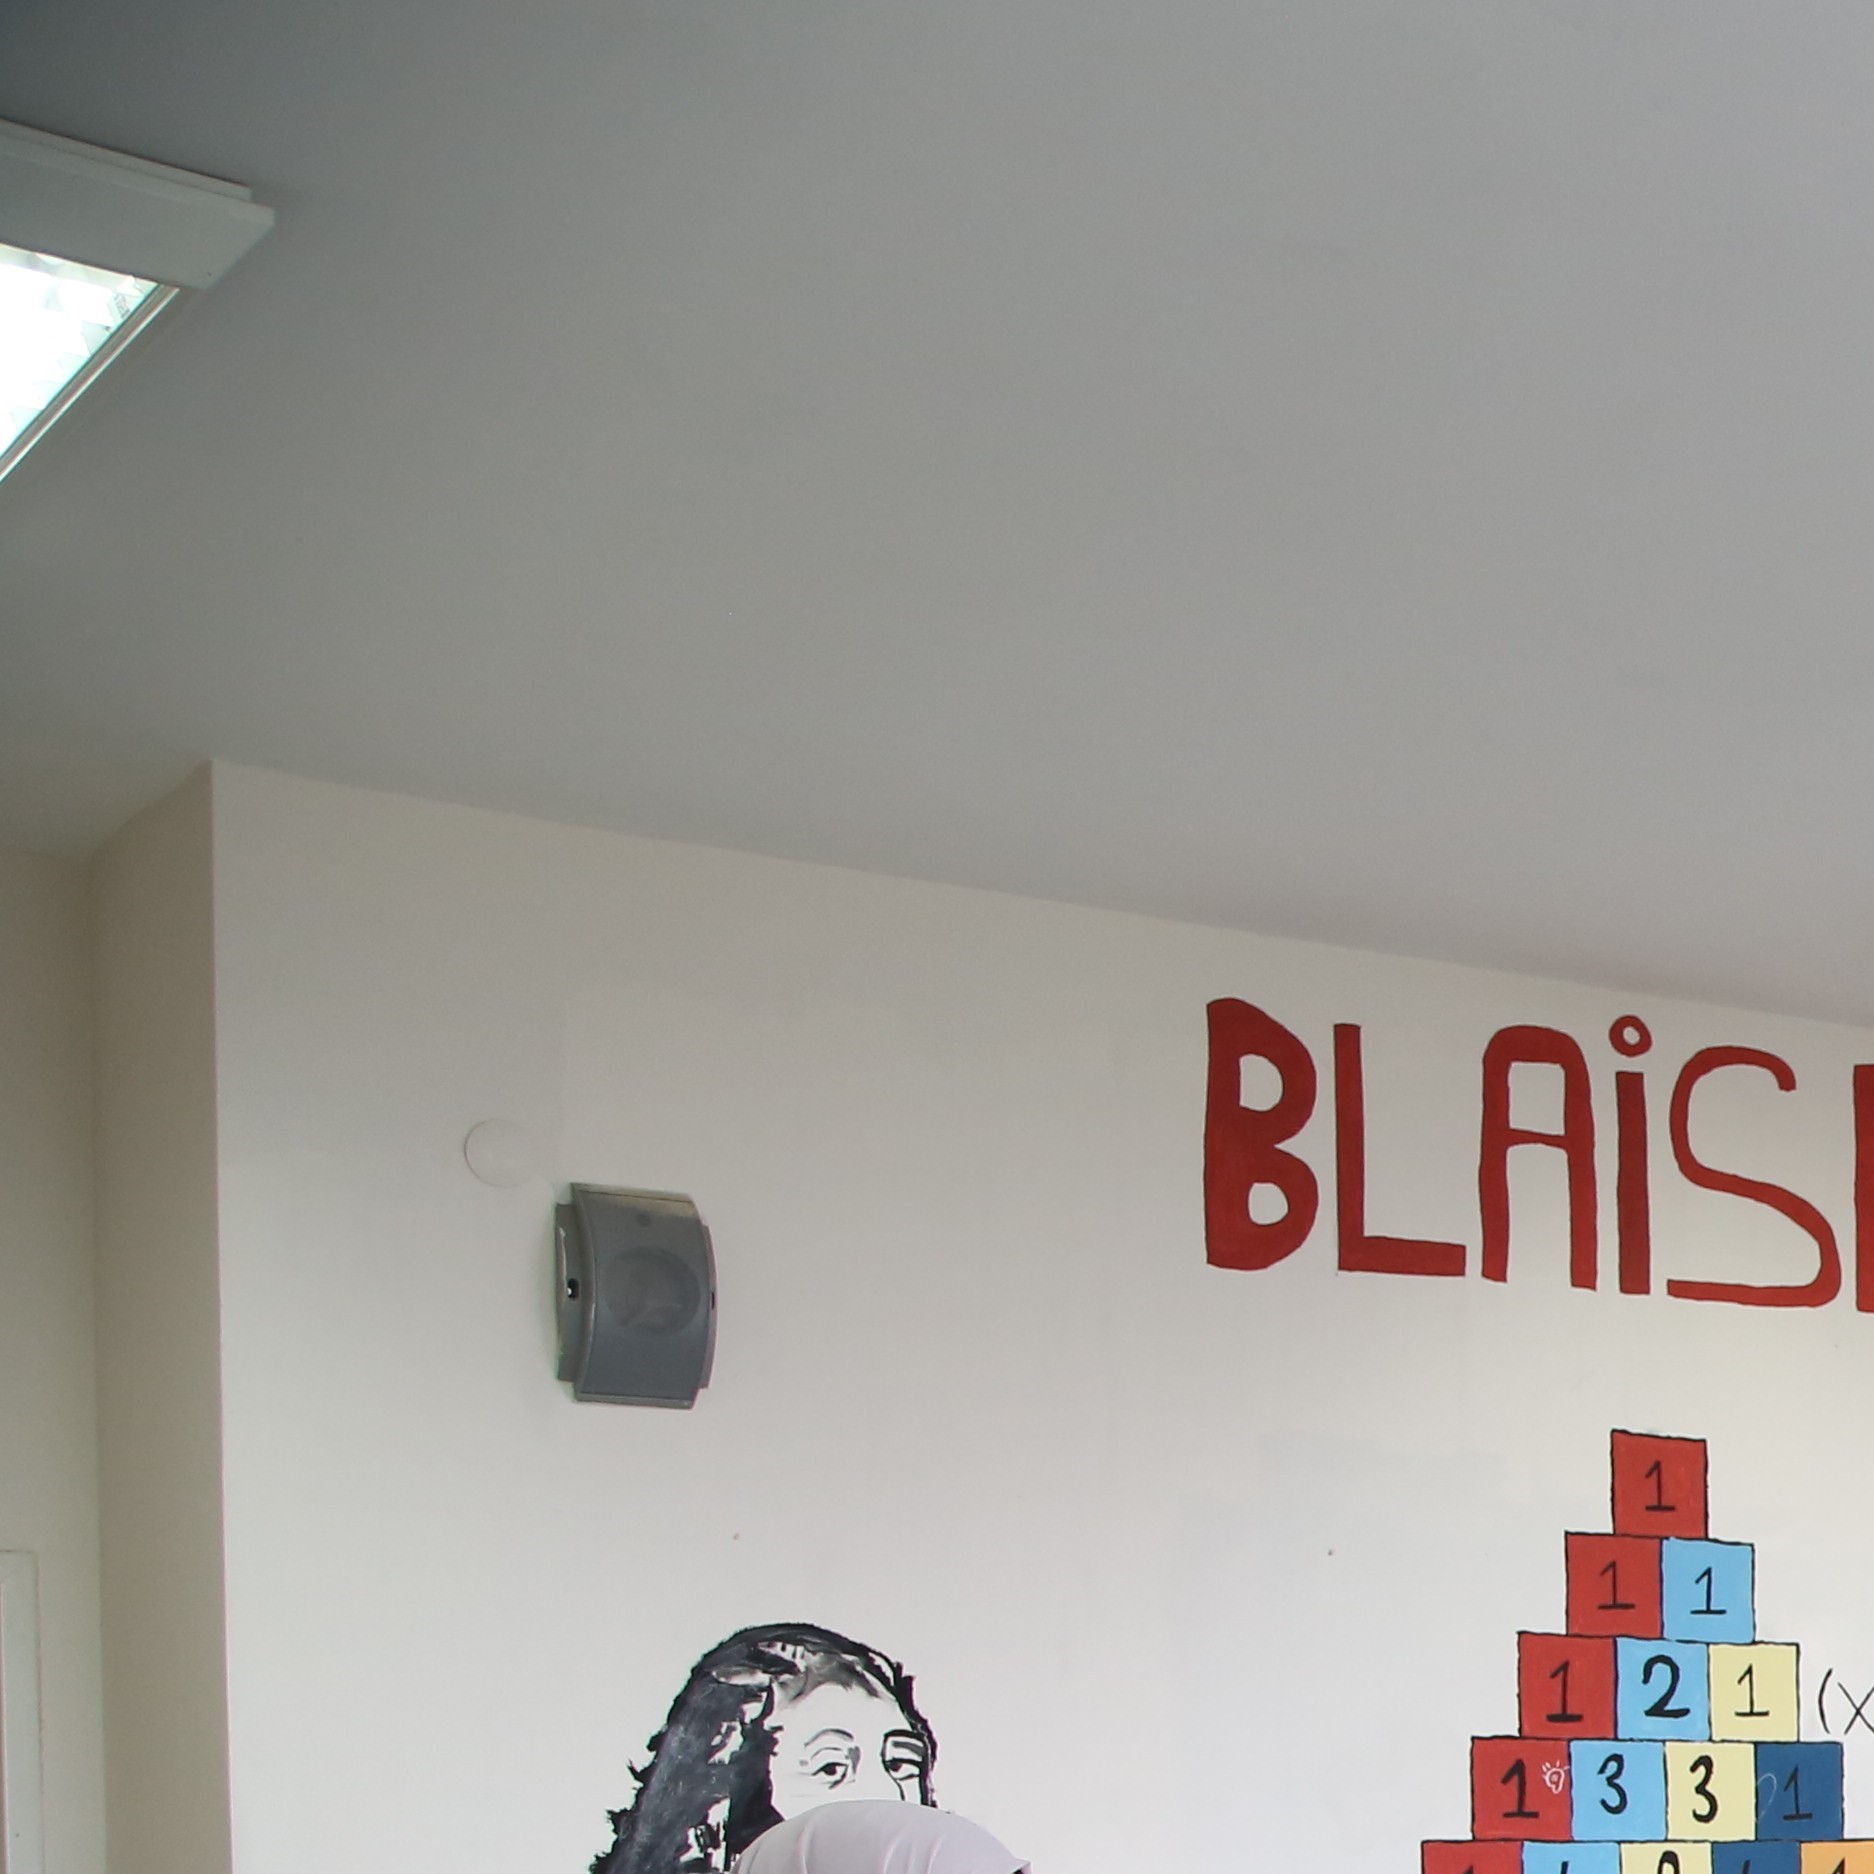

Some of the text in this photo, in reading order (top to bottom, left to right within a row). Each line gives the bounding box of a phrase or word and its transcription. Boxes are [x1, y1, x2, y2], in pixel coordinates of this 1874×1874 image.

[1644, 1461, 1676, 1511] 1
[1598, 1562, 1727, 1616] 1 1
[1546, 1655, 1770, 1723] 1 2 1
[1502, 1757, 1813, 1823] 1 3 3 1
